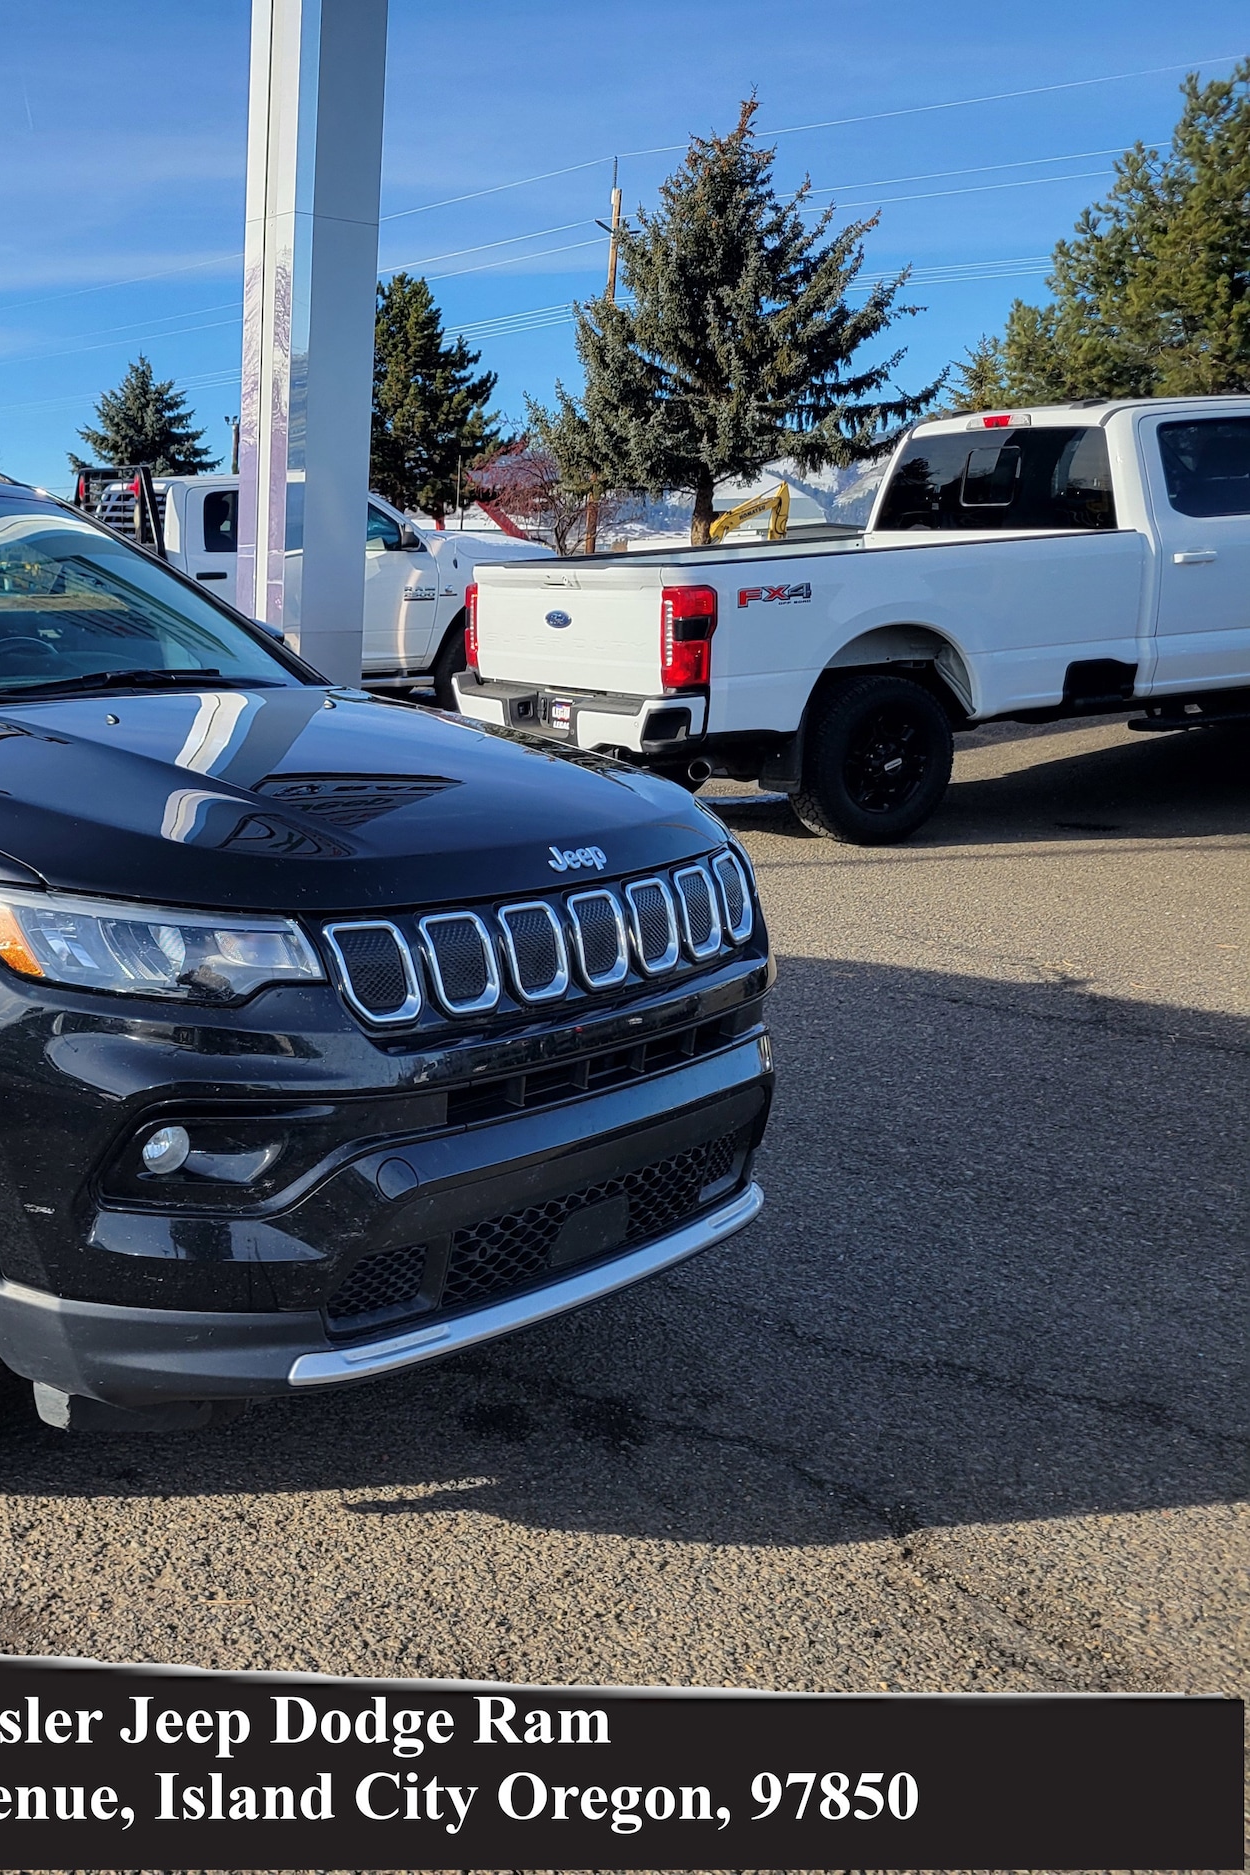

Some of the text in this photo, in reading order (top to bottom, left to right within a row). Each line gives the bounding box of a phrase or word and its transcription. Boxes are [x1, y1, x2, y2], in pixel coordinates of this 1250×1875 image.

[738, 505, 767, 521] KOMATSU
[737, 583, 812, 609] FX4
[547, 846, 607, 873] Jeep
